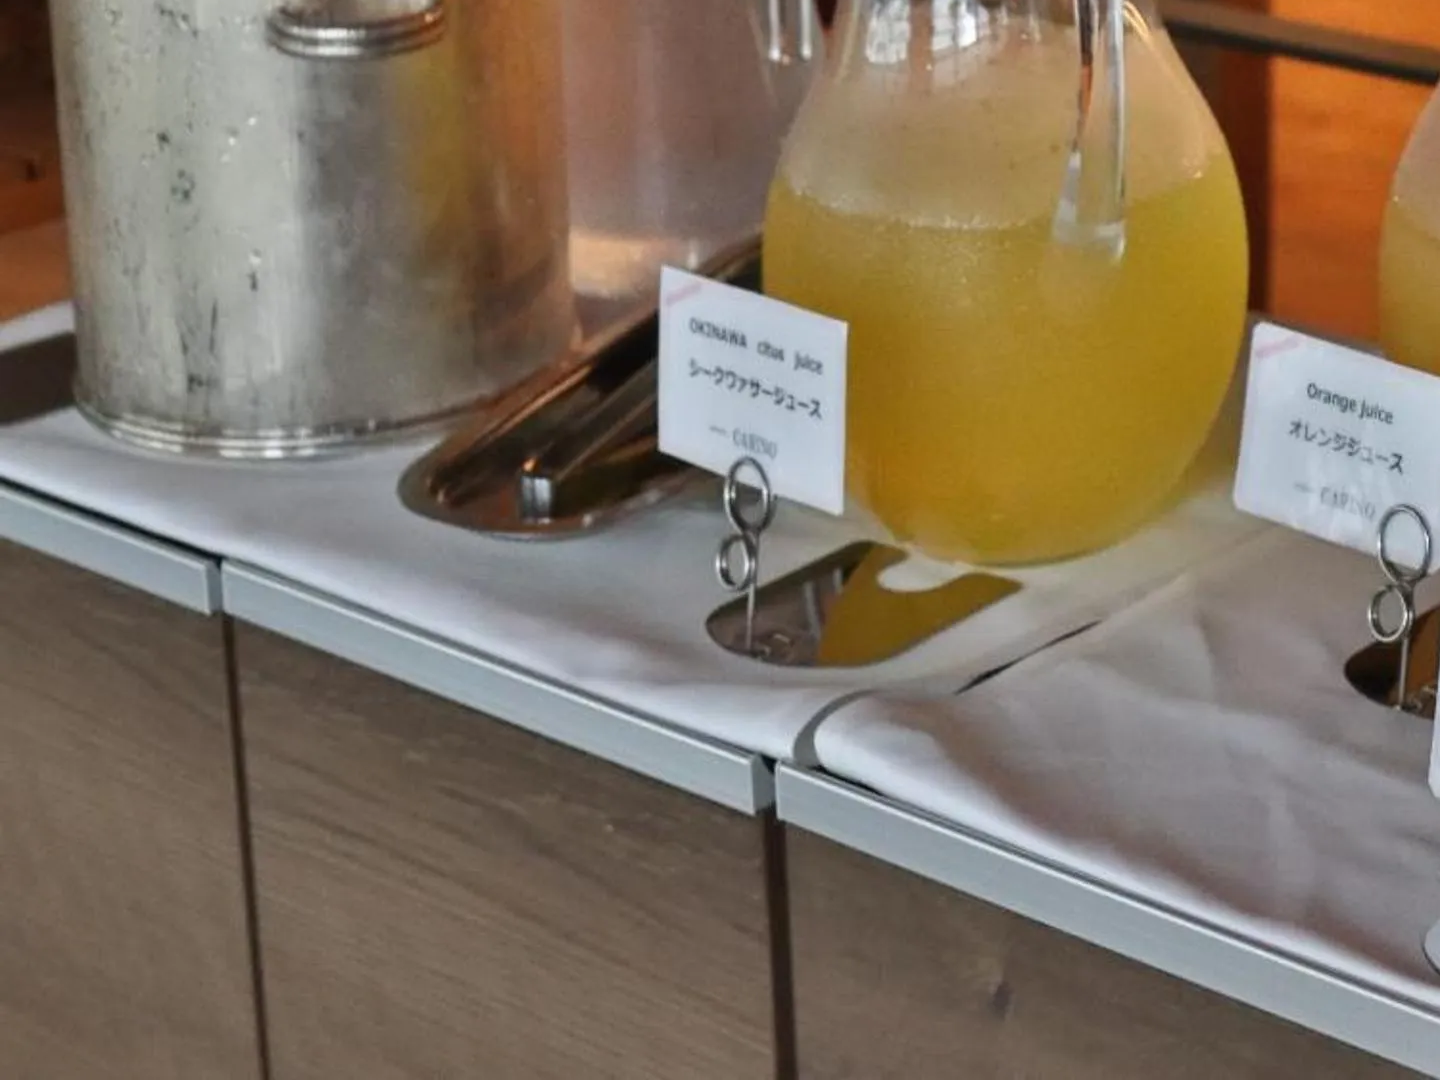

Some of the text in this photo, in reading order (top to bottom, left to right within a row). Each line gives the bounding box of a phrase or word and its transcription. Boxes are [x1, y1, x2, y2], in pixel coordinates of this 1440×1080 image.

[689, 317, 747, 349] OKINAWA
[793, 349, 824, 376] juice
[1306, 381, 1394, 425] Orange juice
[1288, 419, 1404, 474] オレンジジュース
